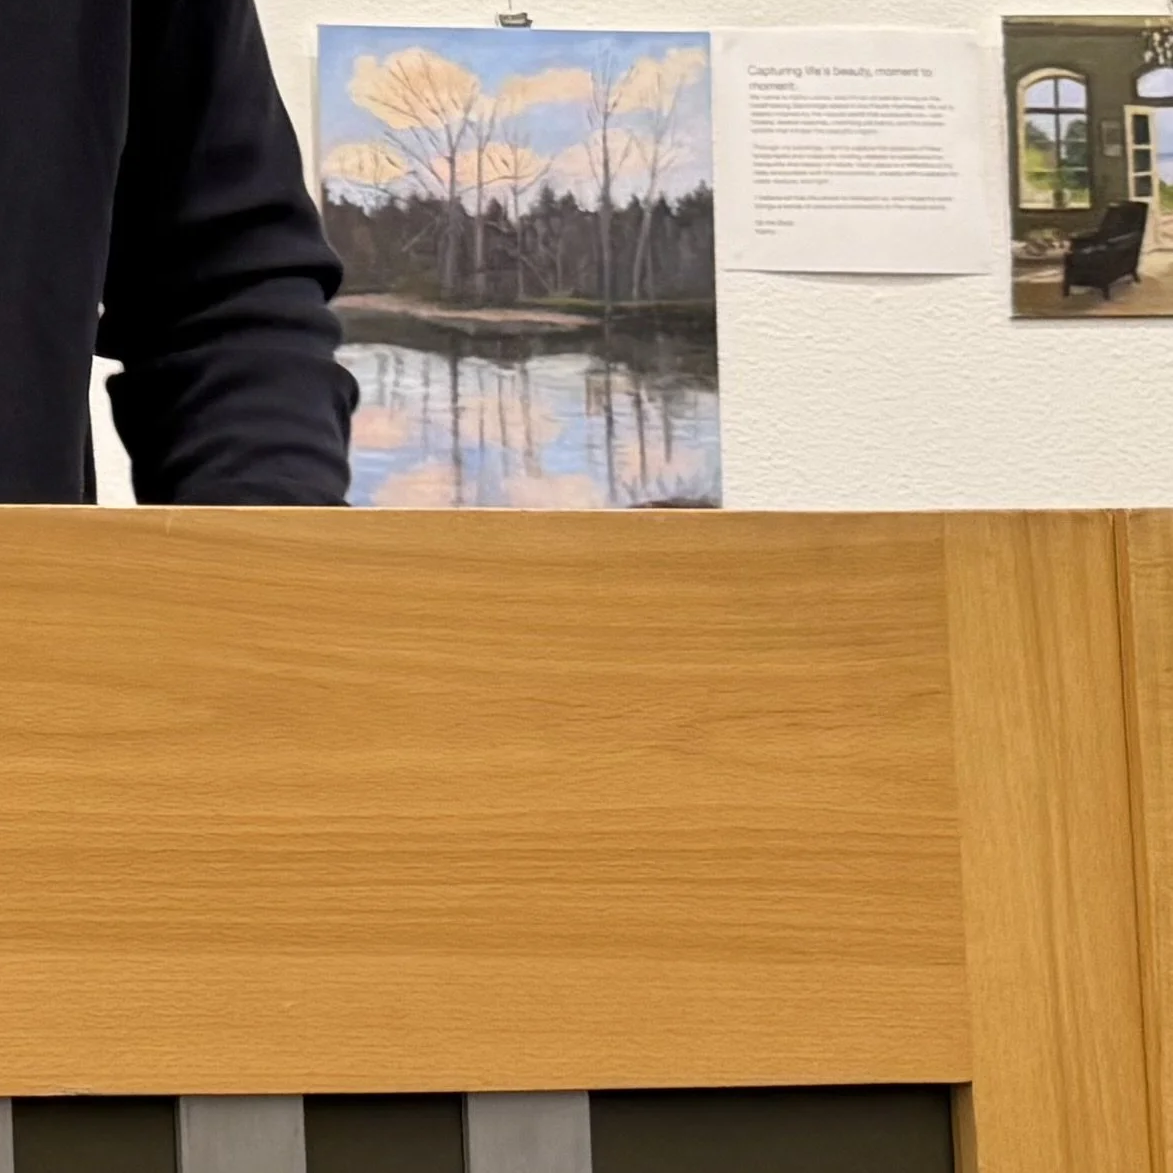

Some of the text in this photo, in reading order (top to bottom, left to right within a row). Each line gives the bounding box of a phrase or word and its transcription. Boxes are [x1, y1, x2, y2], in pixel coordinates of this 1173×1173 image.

[747, 65, 803, 78] Capturing
[875, 67, 919, 77] moment
[920, 67, 933, 77] to
